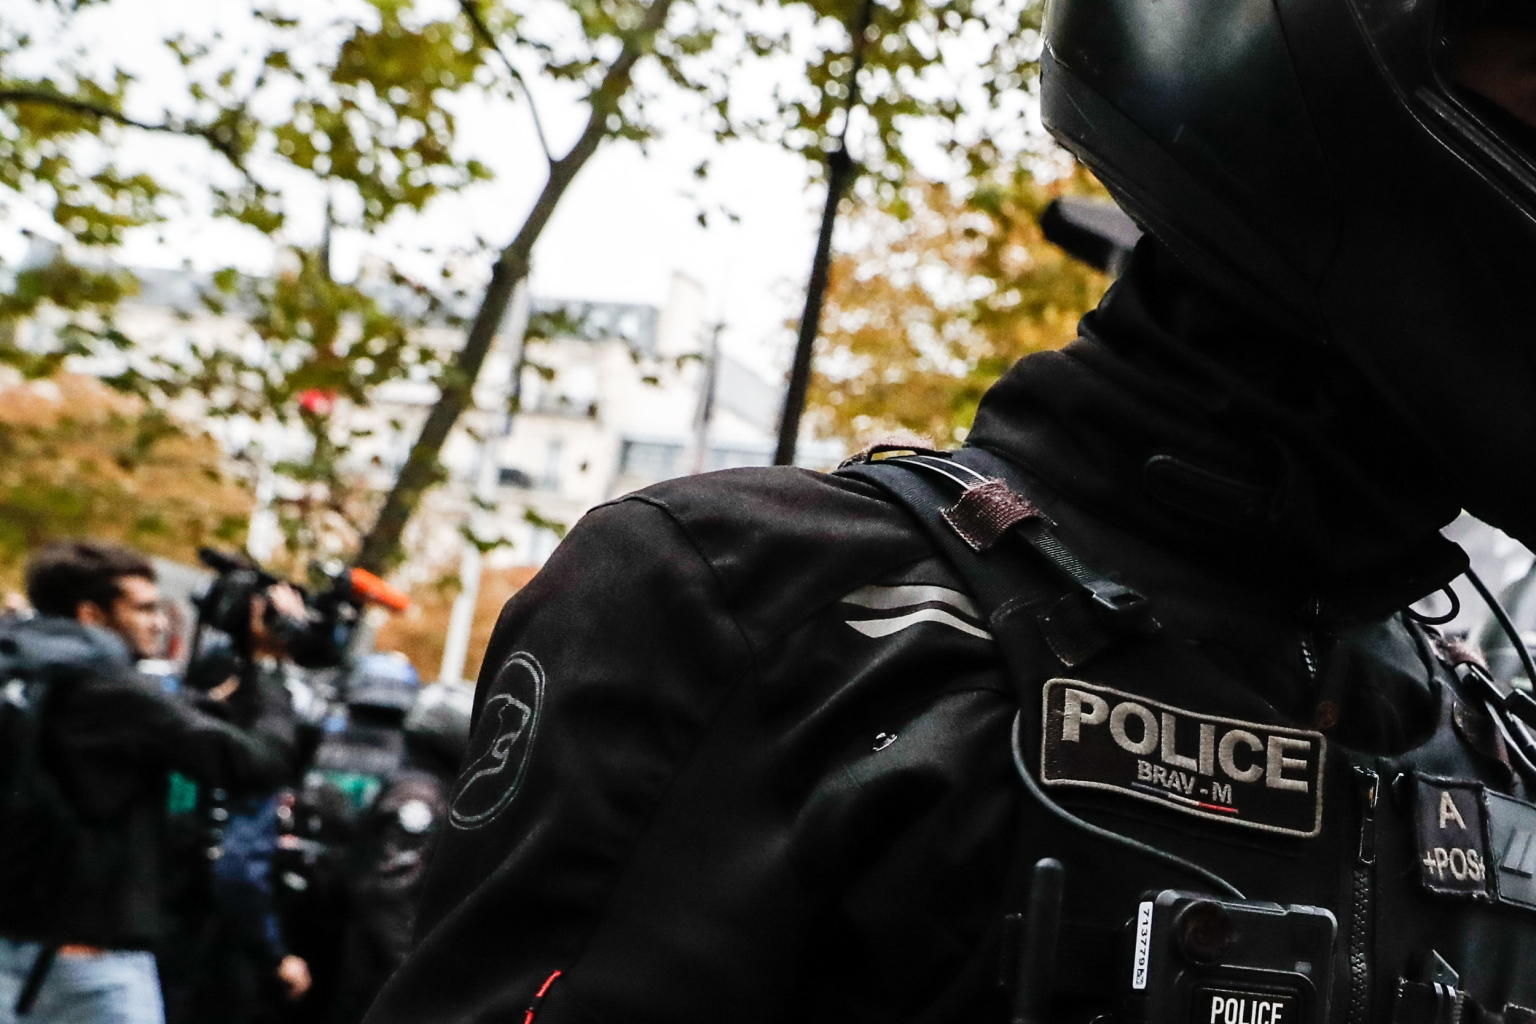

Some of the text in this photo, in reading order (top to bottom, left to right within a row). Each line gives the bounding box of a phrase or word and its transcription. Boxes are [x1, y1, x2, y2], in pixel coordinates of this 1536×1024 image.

[1061, 687, 1311, 794] POLICE
[1137, 758, 1196, 796] BRAV
[1212, 780, 1234, 806] M
[1439, 790, 1467, 830] A
[1138, 908, 1151, 967] 713779
